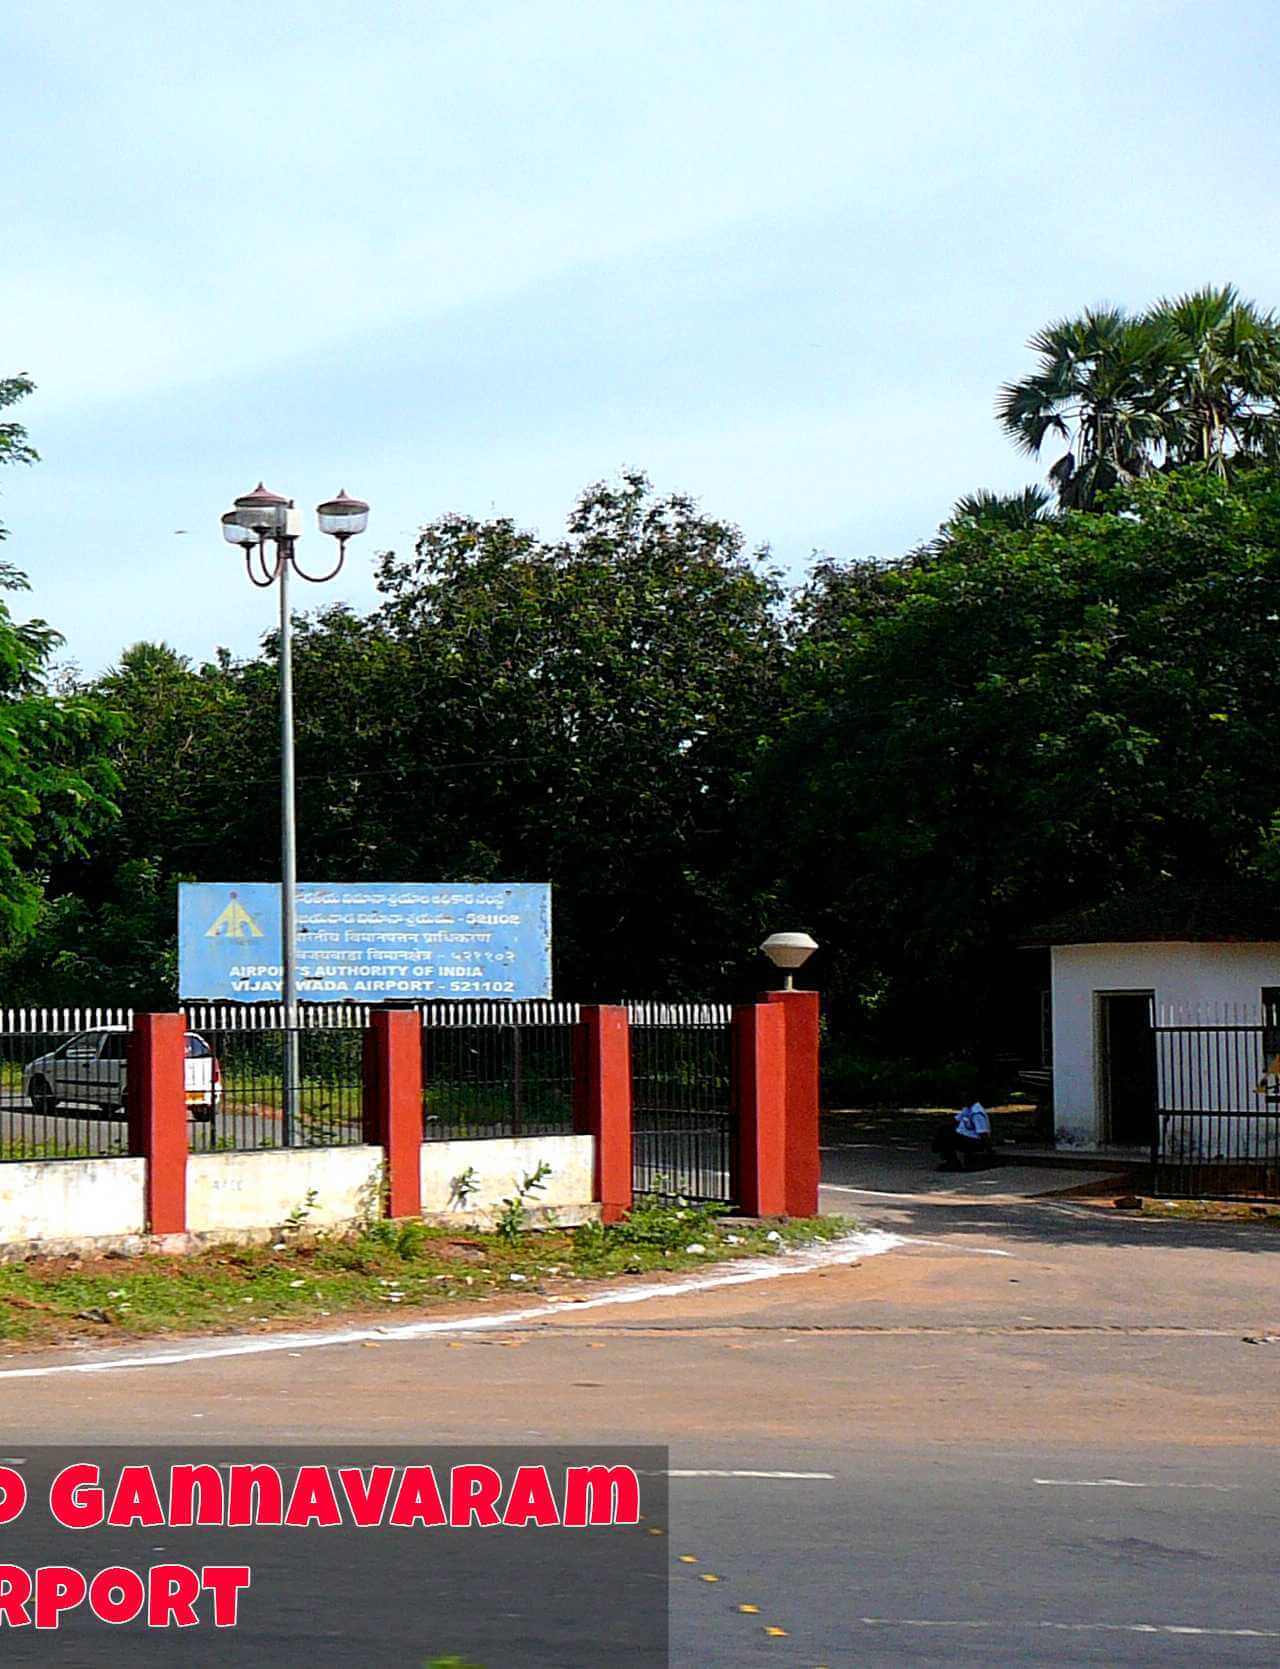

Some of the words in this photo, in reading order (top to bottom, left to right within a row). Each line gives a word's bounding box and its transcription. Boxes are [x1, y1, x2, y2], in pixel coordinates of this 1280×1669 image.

[465, 912, 521, 925] 521102
[314, 965, 409, 977] AUTHORITY
[412, 965, 435, 977] OF
[438, 965, 484, 977] INDIA
[231, 980, 349, 992] VIJAYWADA
[354, 980, 434, 992] AIRPORT
[449, 980, 515, 992] 521102
